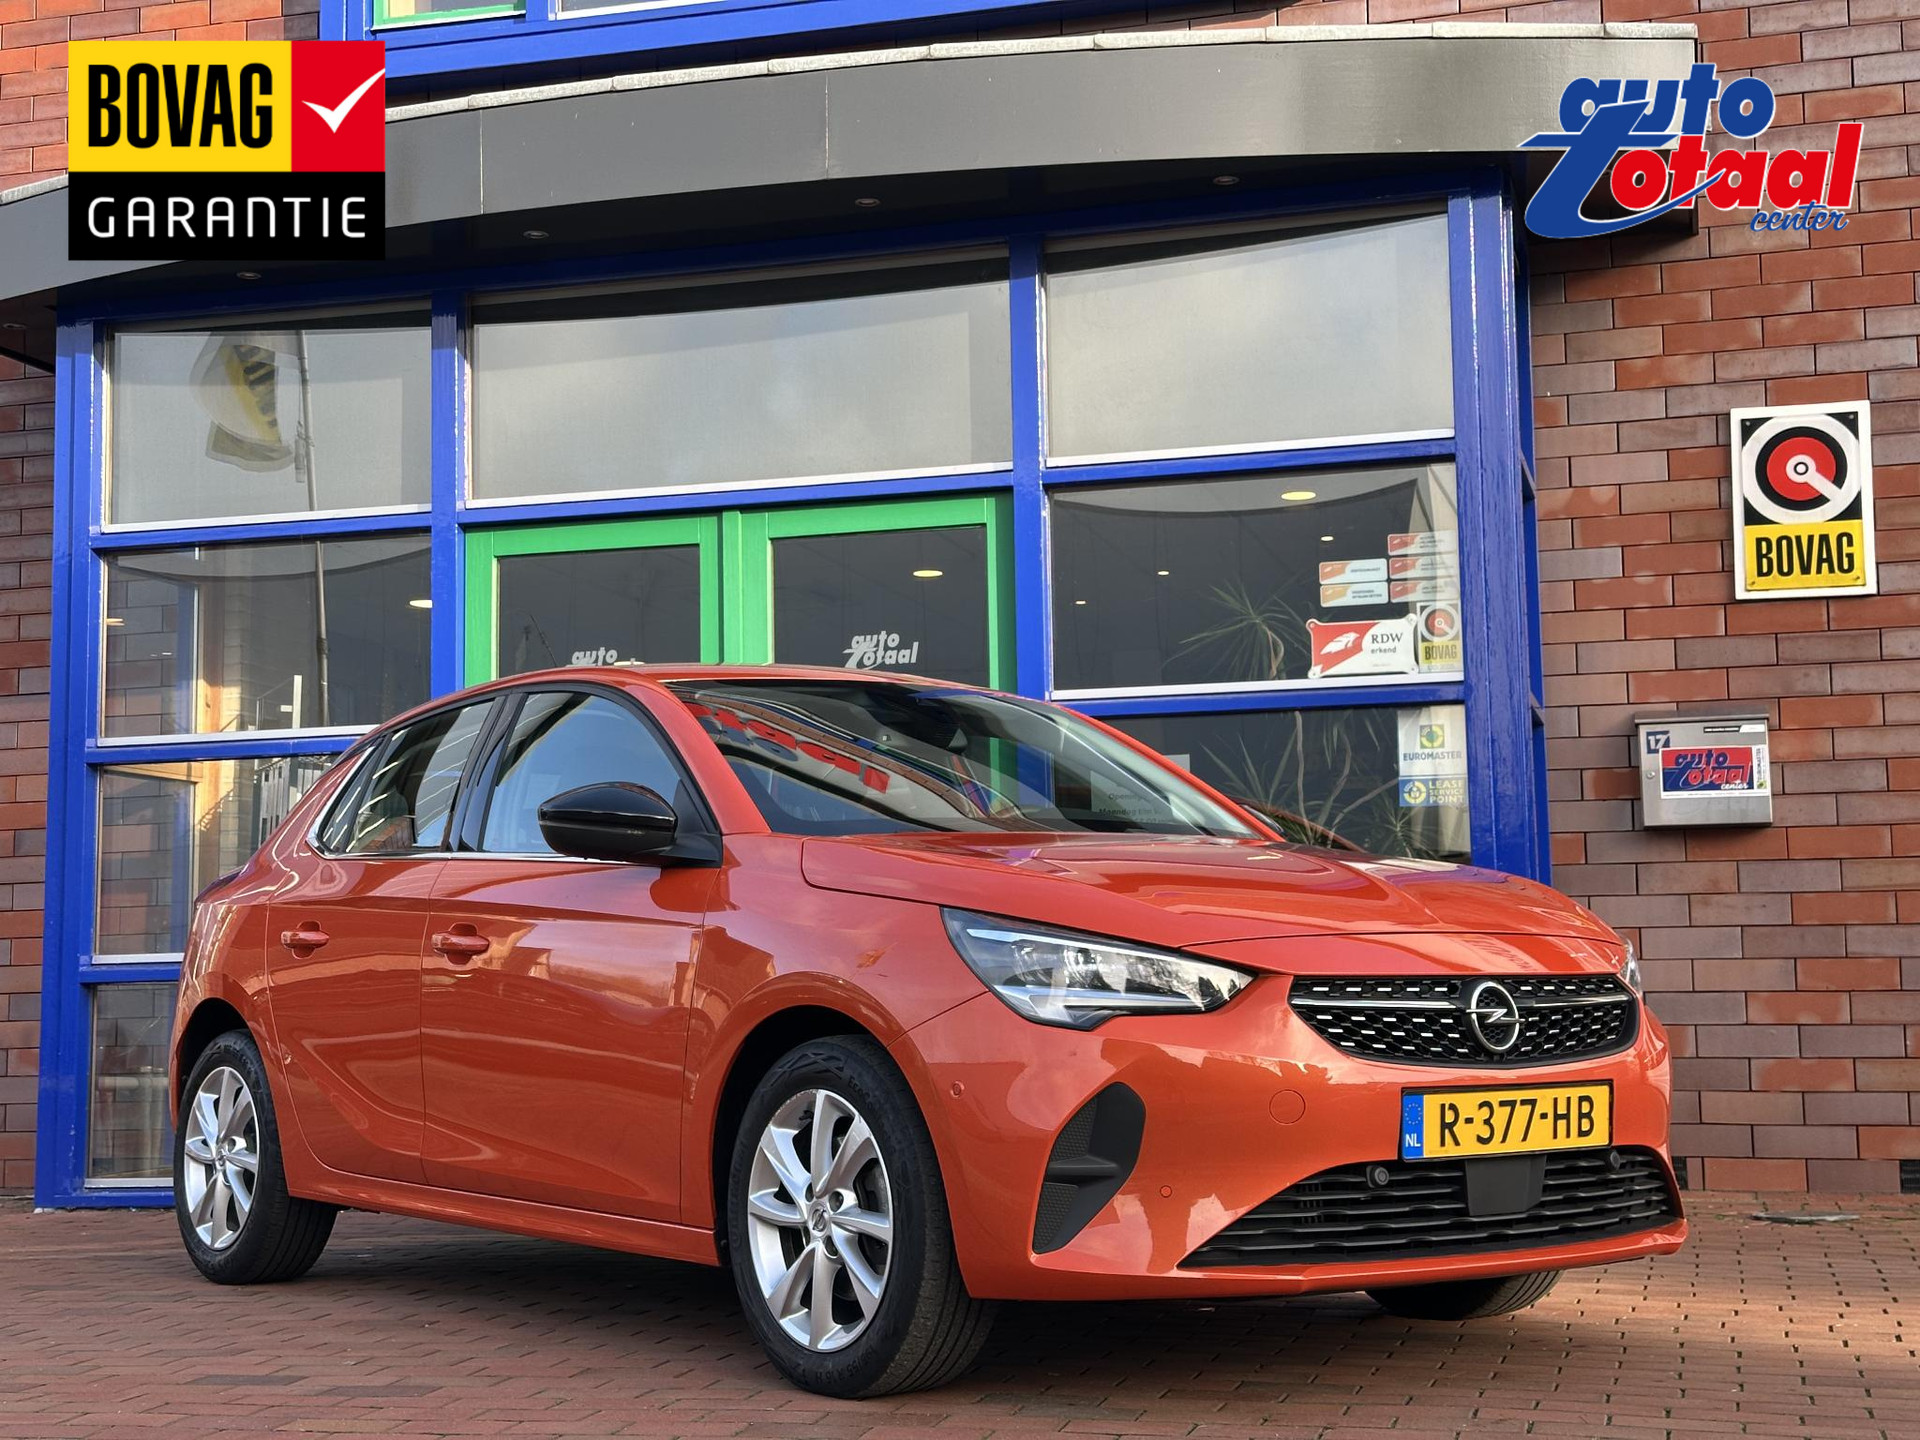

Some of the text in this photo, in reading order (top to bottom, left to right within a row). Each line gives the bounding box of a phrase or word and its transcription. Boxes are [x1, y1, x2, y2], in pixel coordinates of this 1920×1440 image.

[1755, 532, 1855, 578] BOVAG
[851, 630, 900, 649] auto
[1371, 632, 1403, 644] RDW
[571, 646, 618, 666] auto
[1370, 646, 1397, 654] erkend
[1424, 644, 1457, 661] BOVAG
[1648, 733, 1669, 750] 17
[1403, 751, 1462, 761] EUROMASTER
[1674, 749, 1729, 768] auto
[1720, 780, 1750, 791] center
[1429, 795, 1465, 804] POINT
[1439, 1094, 1595, 1148] R-377-HB
[1404, 1133, 1421, 1148] NL
